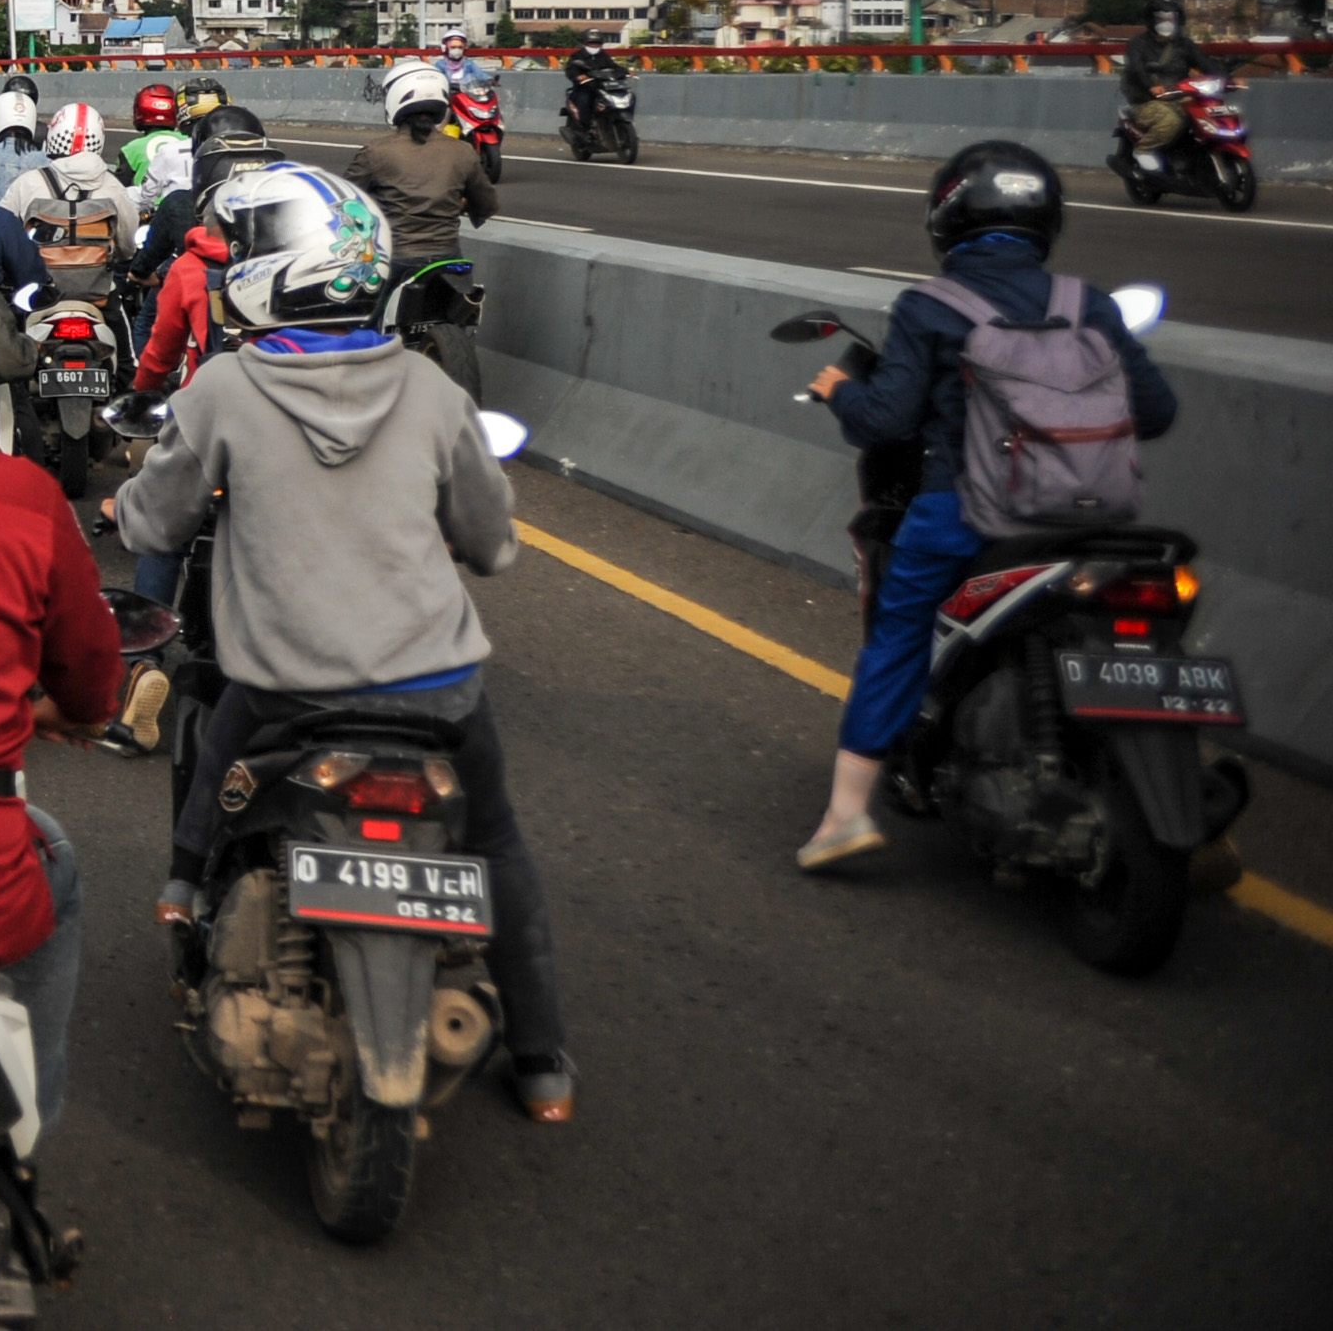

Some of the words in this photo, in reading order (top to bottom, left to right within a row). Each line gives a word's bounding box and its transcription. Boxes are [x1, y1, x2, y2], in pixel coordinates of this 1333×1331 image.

[41, 372, 48, 384] D
[94, 371, 107, 383] IV
[1066, 660, 1083, 682] D
[1099, 661, 1160, 685] 4038
[1177, 666, 1226, 690] ABK
[297, 854, 318, 883] D
[337, 859, 411, 891] 4199
